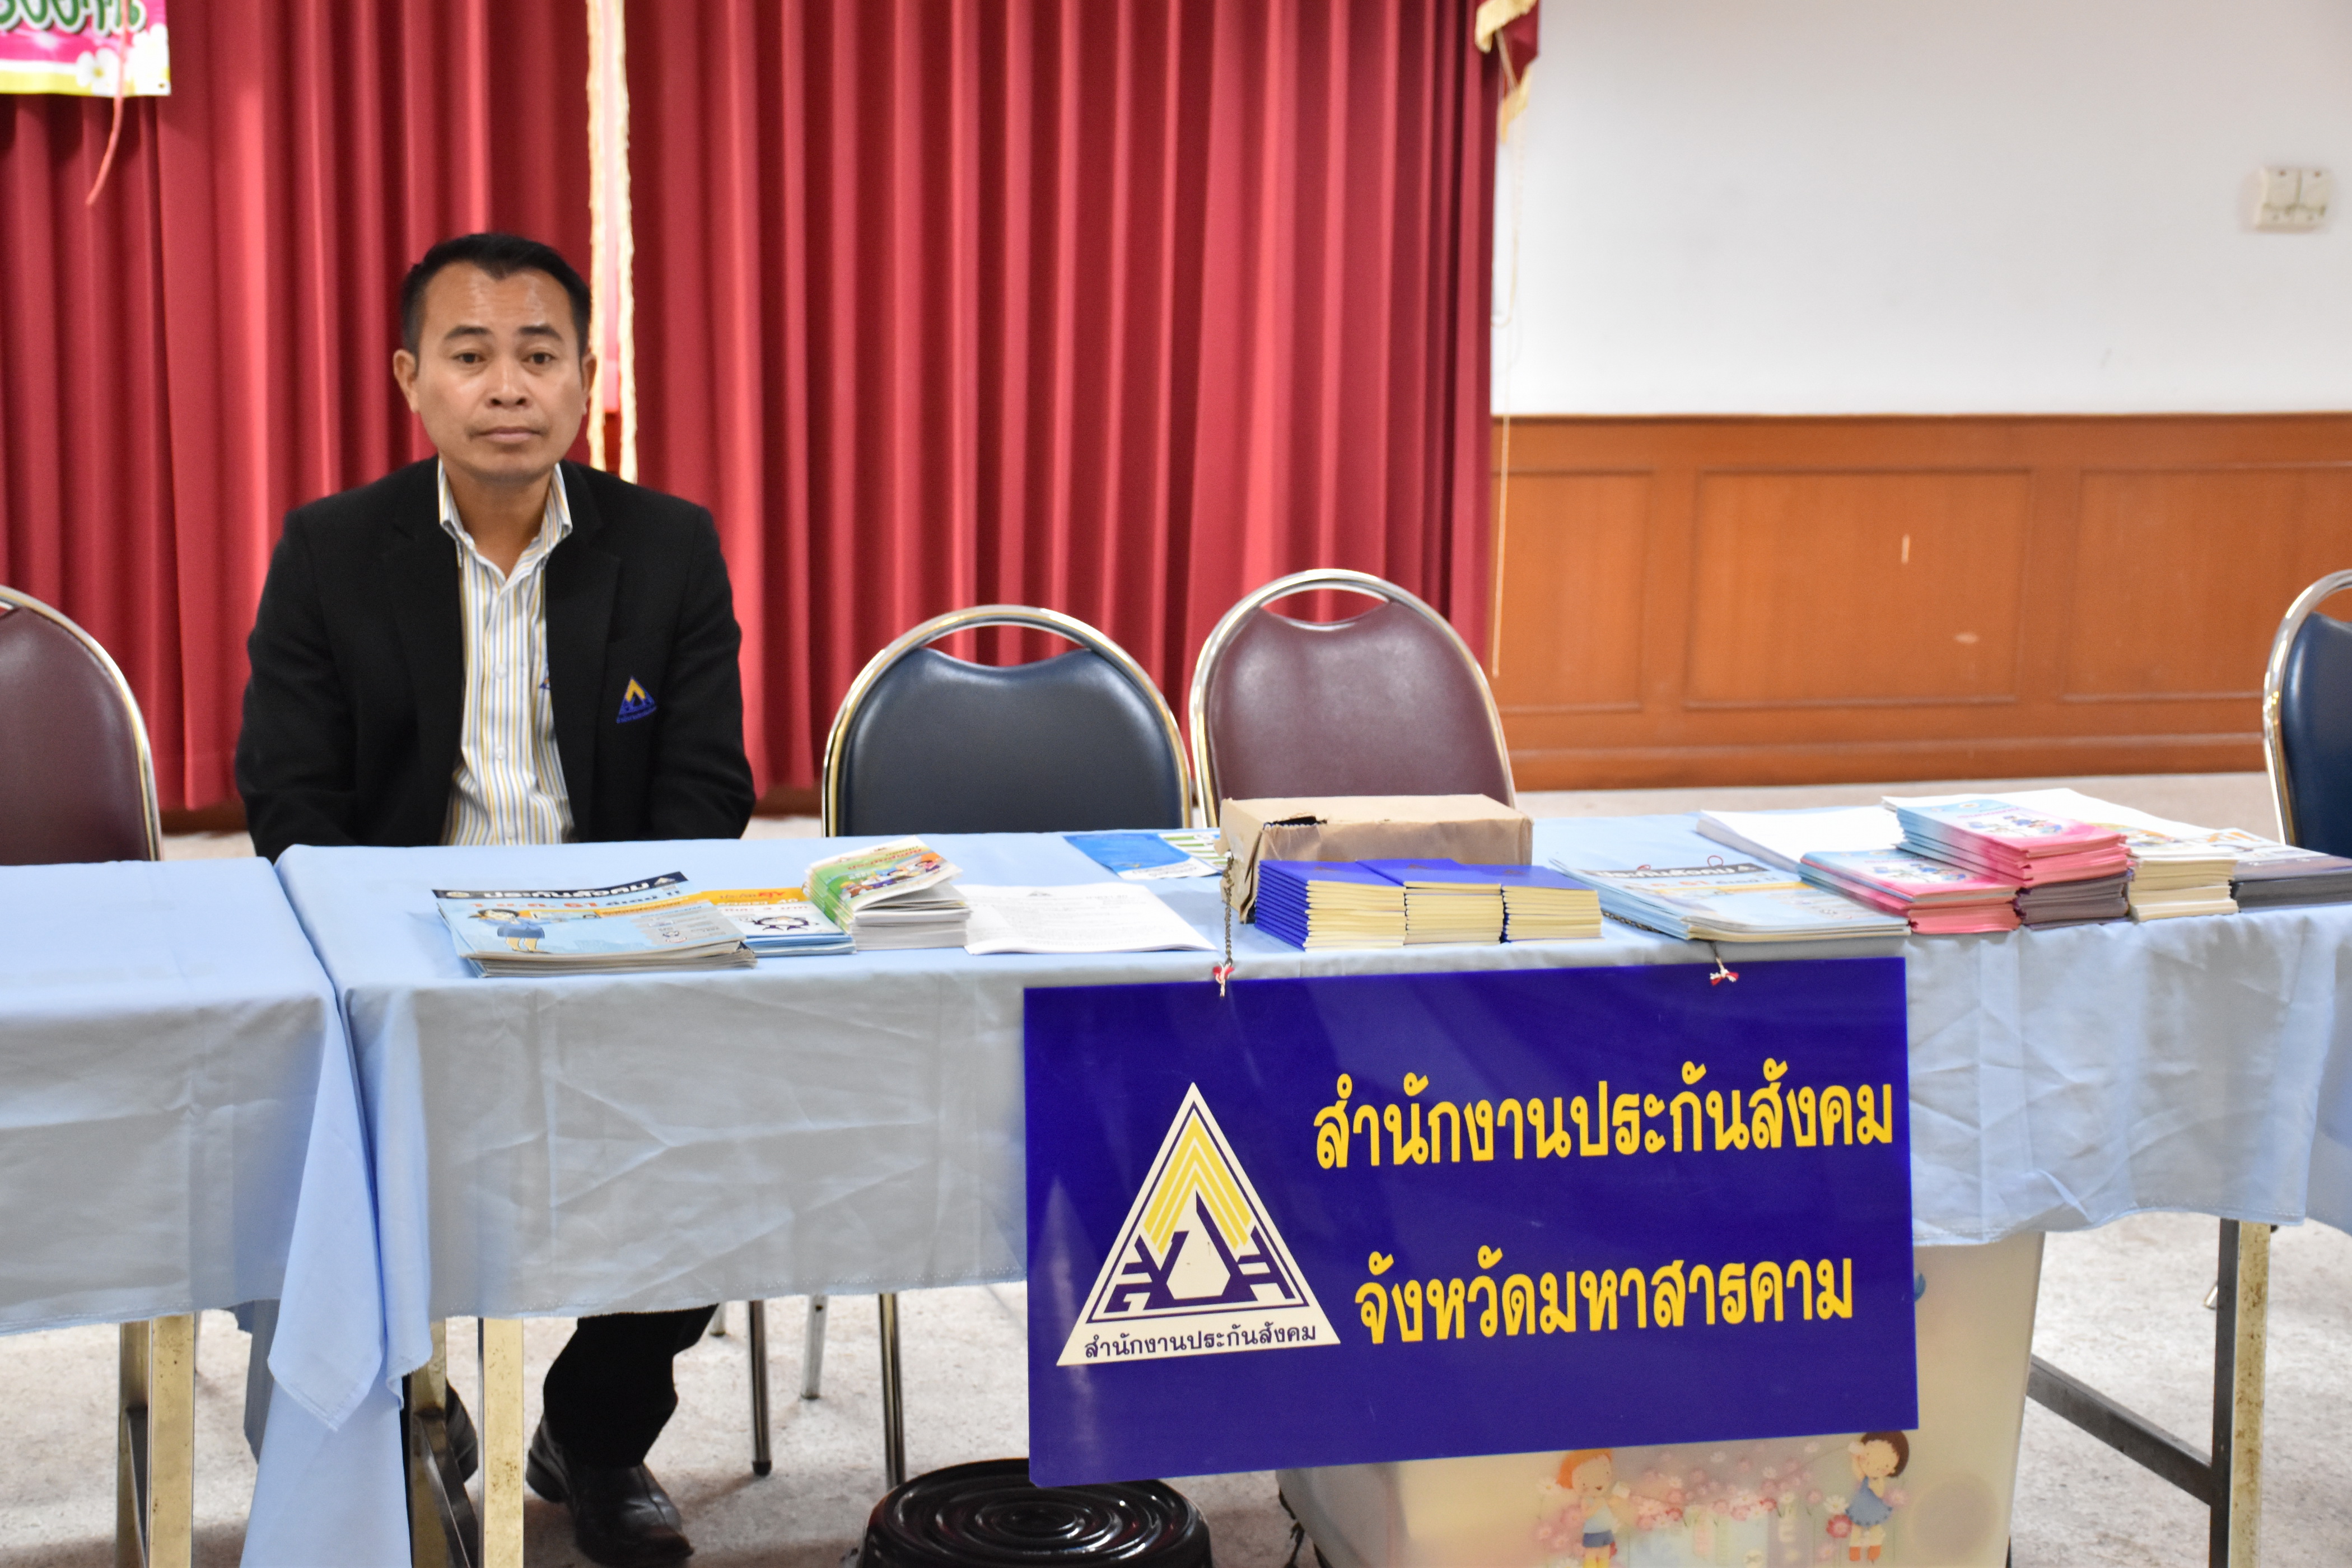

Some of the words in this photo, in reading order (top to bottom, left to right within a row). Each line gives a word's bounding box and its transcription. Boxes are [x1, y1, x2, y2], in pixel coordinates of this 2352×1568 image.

[1314, 1058, 1893, 1169] สำนักงานประกันสังคม
[1084, 1322, 1317, 1358] สำนักงานประกันสังคม
[1355, 1245, 1853, 1344] จังหวัดมหาสารคาม
